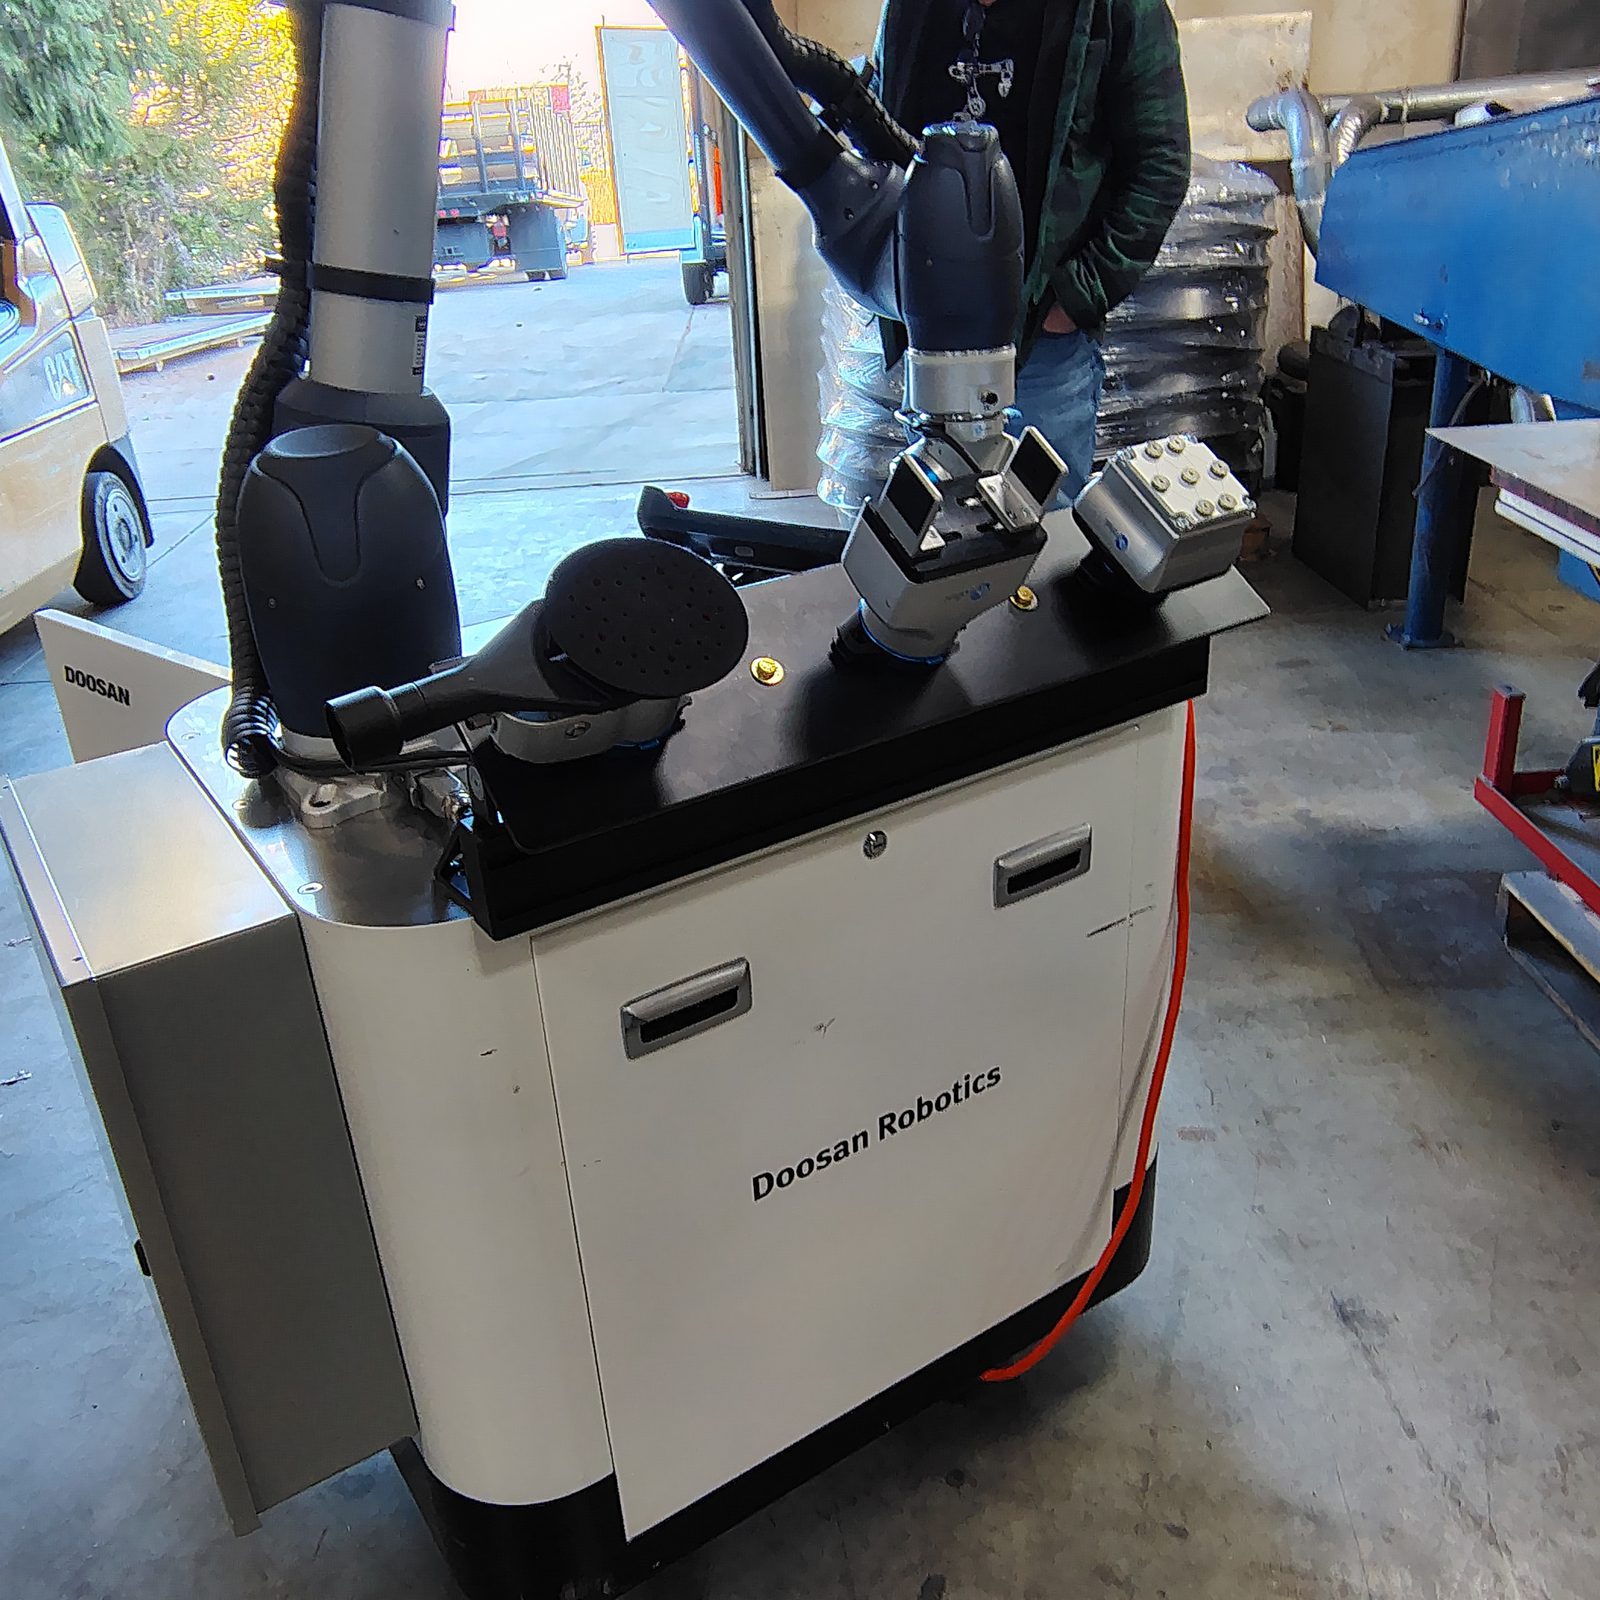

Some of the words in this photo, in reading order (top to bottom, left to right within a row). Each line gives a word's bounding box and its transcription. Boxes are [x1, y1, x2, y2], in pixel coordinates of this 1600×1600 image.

[43, 349, 84, 400] CAT
[64, 665, 130, 706] DOOSAN
[752, 1129, 869, 1201] Doosan
[878, 1066, 1001, 1141] Robotics
